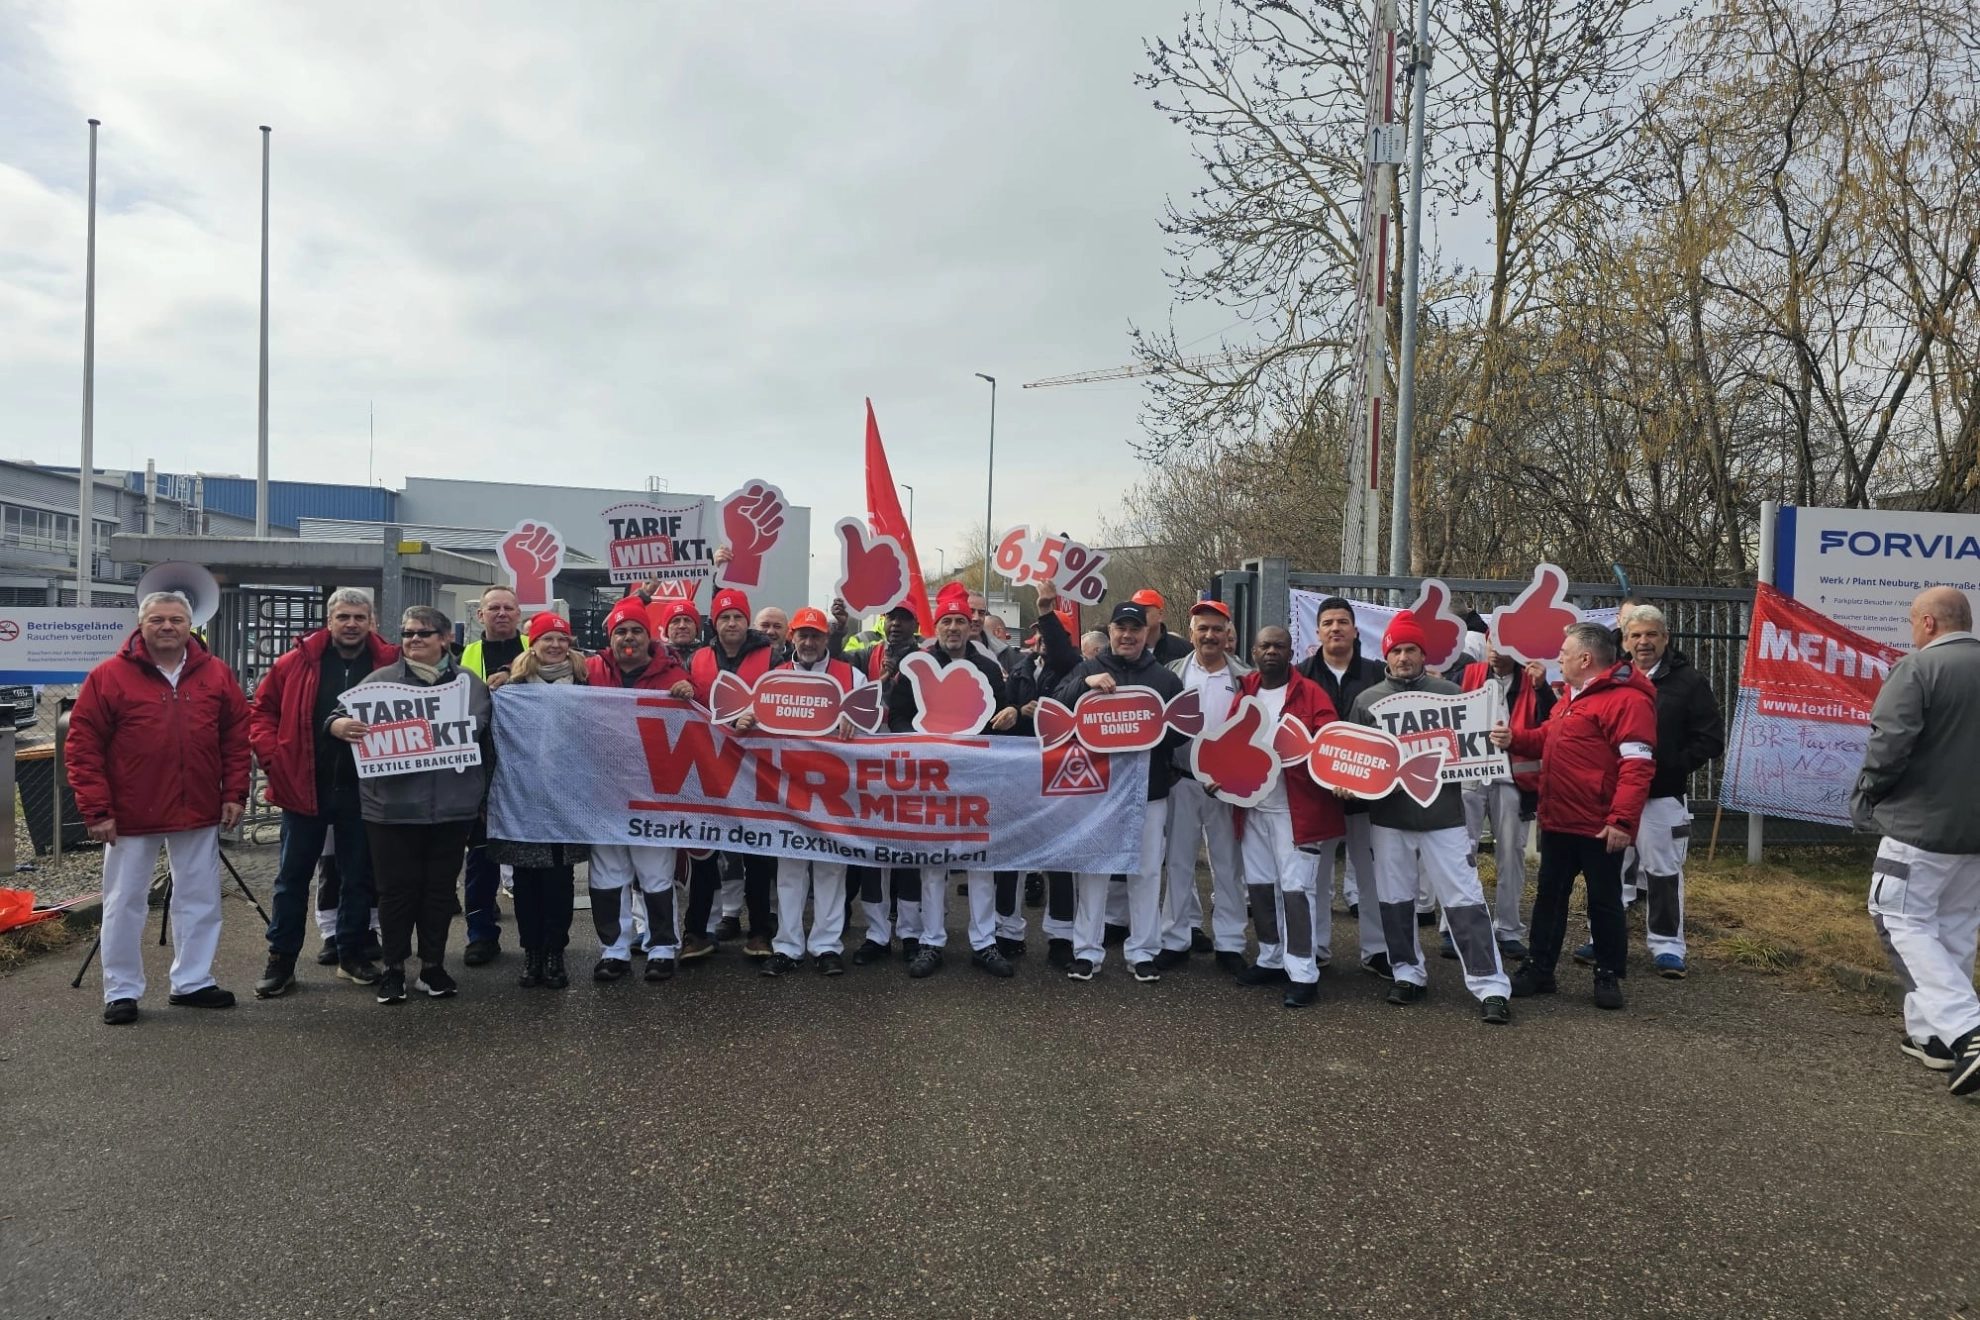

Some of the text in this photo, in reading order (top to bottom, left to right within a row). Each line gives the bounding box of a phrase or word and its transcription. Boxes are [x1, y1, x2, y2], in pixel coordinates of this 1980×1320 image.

[609, 516, 681, 539] TARIF
[1820, 531, 1980, 559] FORVIA
[657, 568, 709, 579] BRANCHEN
[997, 529, 1104, 600] 6,5%
[1820, 576, 1844, 585] Werk
[1852, 577, 1877, 586] Plant
[1864, 598, 1893, 606] Besucher
[27, 621, 124, 632] Betriebsgelände
[27, 633, 113, 641] Rauchen verboten
[352, 696, 440, 723] TARIF
[760, 693, 833, 707] MITGLIEDER-
[776, 706, 815, 719] BONUS
[1083, 709, 1155, 725] MITGLIEDER-
[1382, 704, 1467, 737] TARIF
[1100, 722, 1140, 736] BONUS
[361, 753, 477, 774] TEXTILE BRANCHEN
[635, 716, 856, 818] WIR
[1318, 743, 1391, 771] MITGLIEDER-
[855, 751, 949, 792] FÜR
[1331, 759, 1371, 780] BONUS
[1441, 764, 1505, 779] BRANCHEN
[858, 792, 990, 827] MEHR
[628, 818, 987, 865] Stark in den Textilen Branchen
